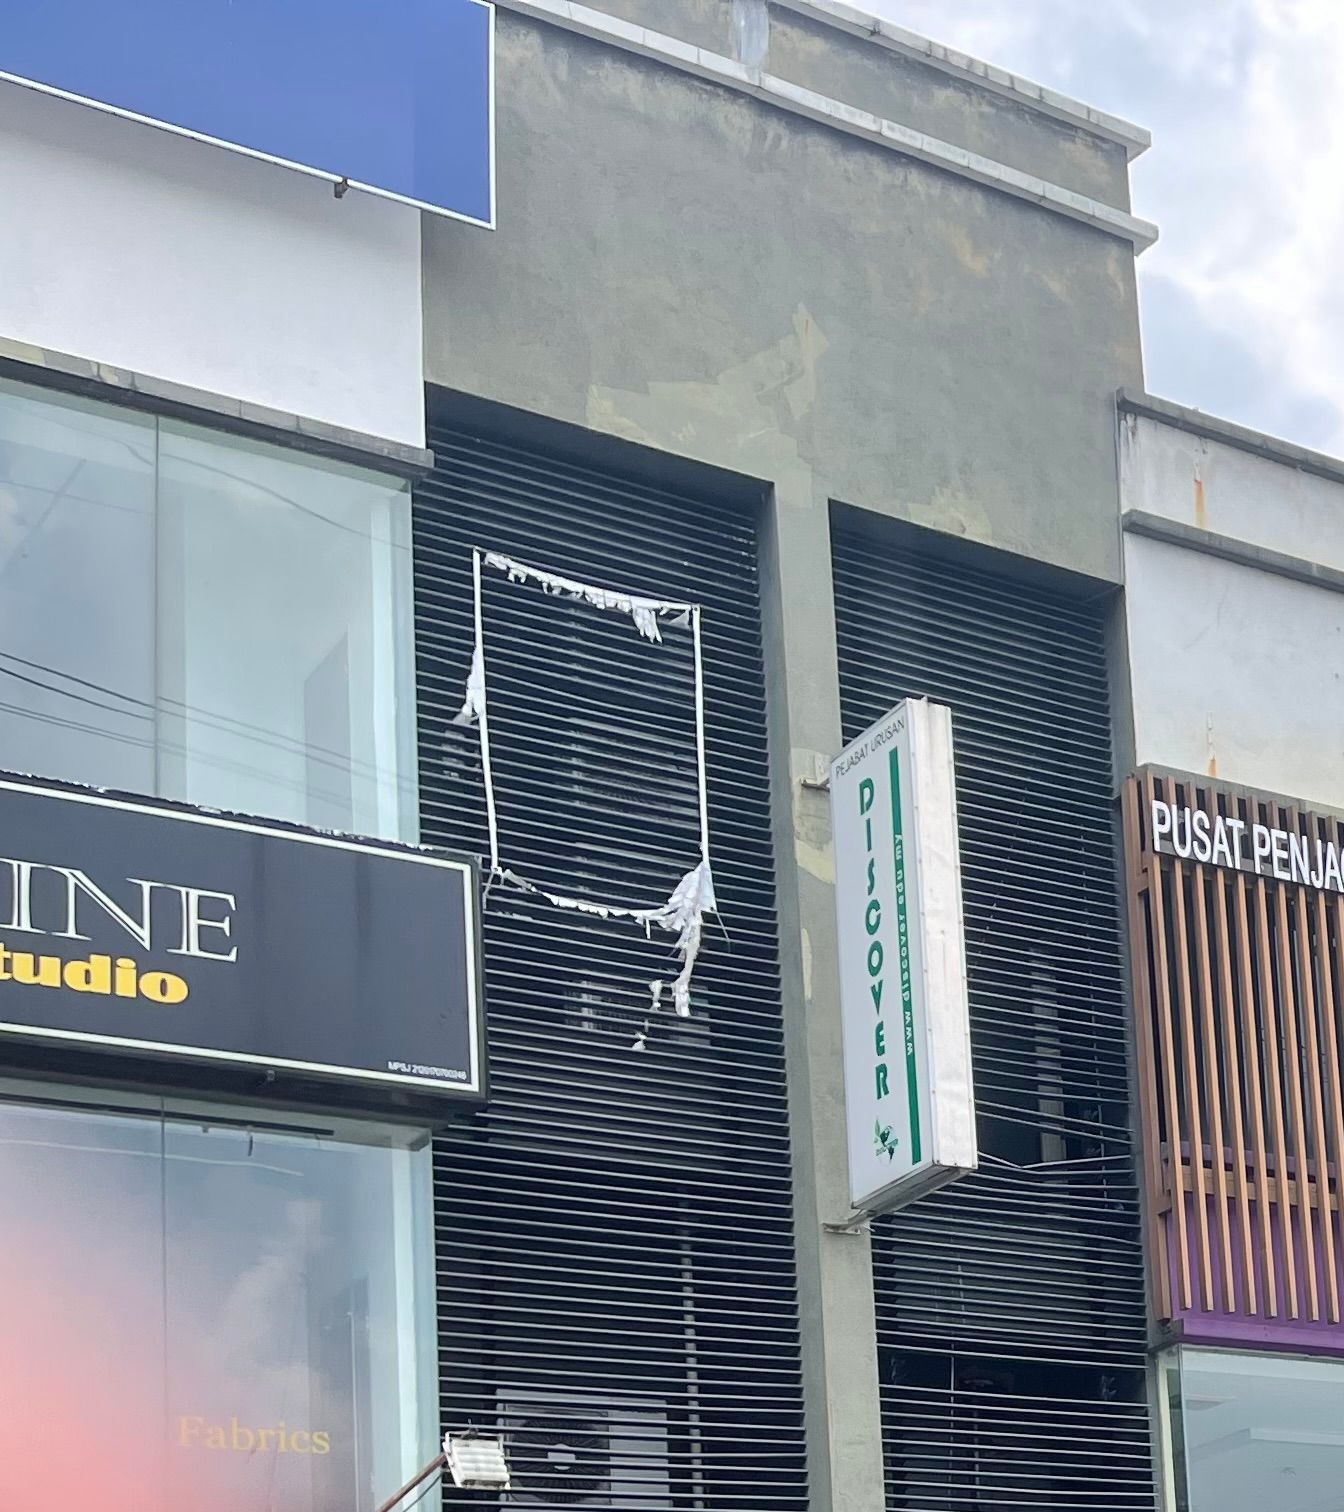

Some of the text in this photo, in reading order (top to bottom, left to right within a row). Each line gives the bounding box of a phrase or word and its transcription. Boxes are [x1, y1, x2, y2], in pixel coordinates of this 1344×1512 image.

[836, 715, 905, 779] PEJABAT URUSAN
[1152, 799, 1245, 870] PUSAT
[858, 776, 890, 1101] DISCOVER
[177, 1414, 332, 1455] Fabrics
